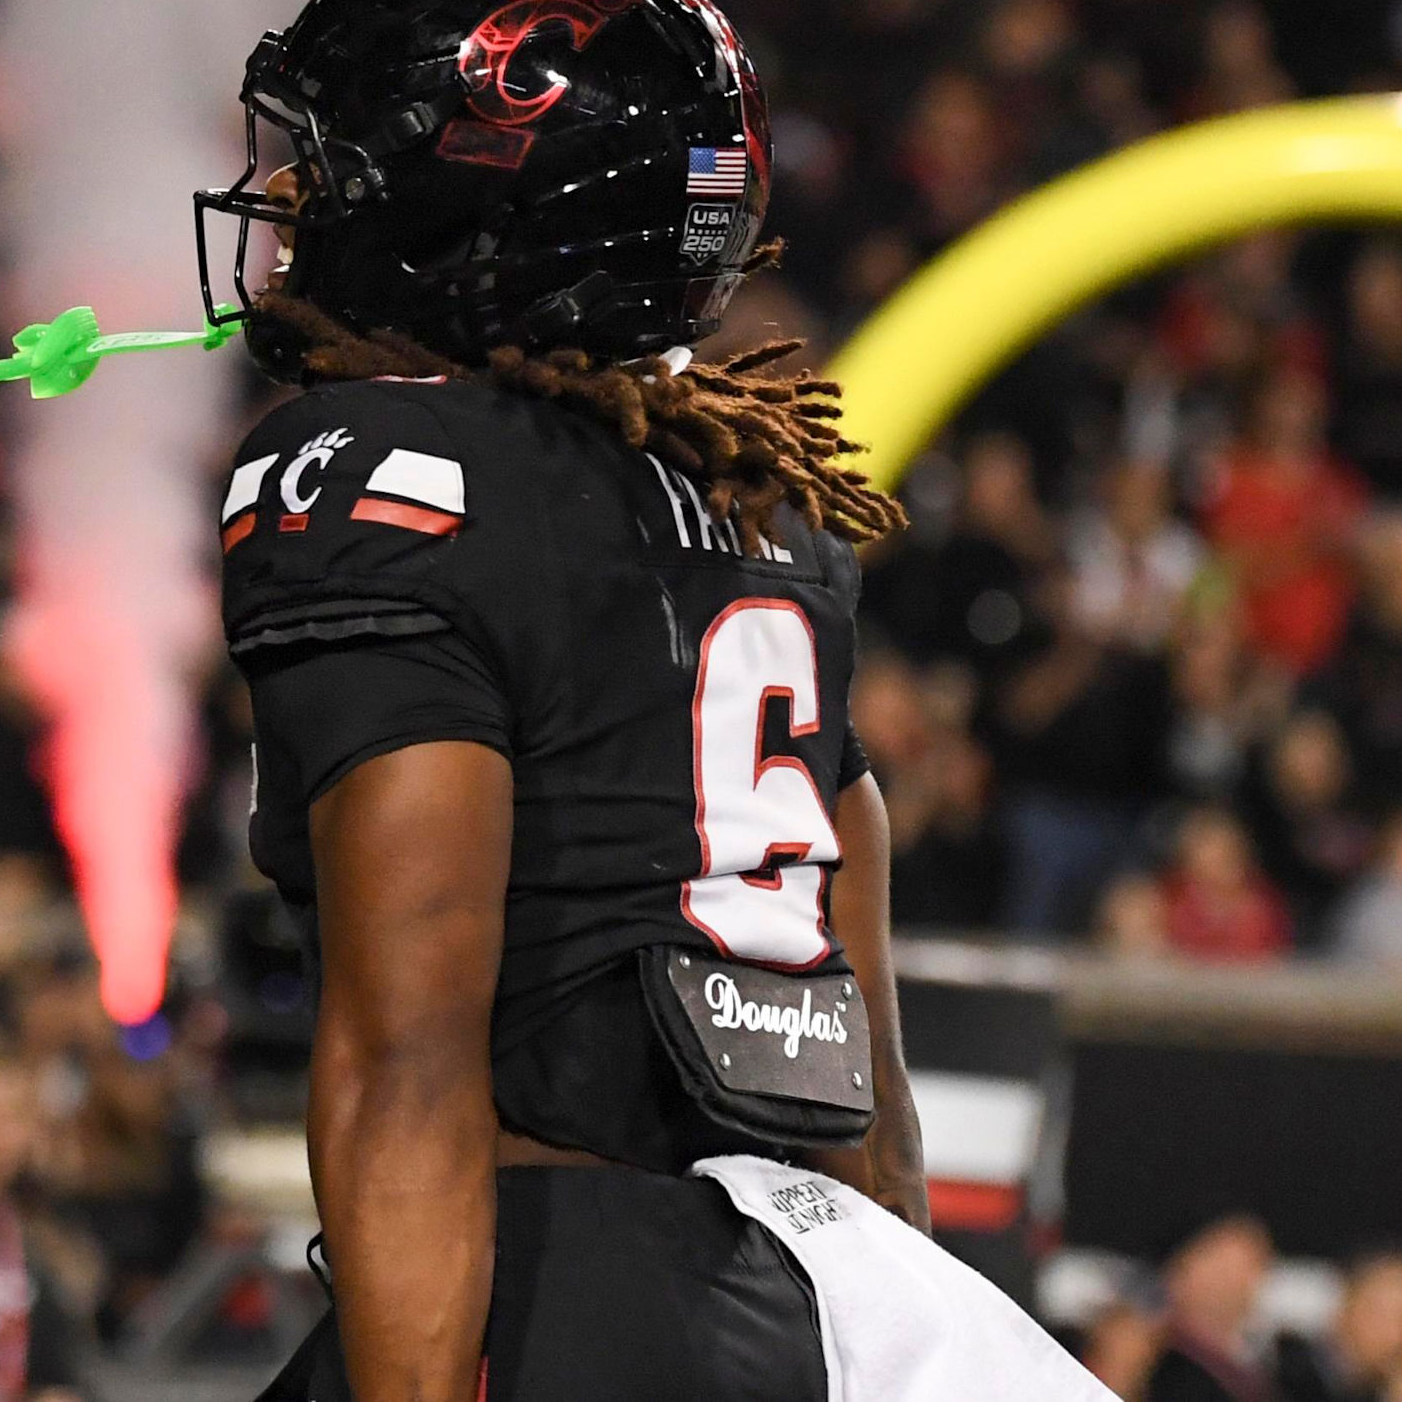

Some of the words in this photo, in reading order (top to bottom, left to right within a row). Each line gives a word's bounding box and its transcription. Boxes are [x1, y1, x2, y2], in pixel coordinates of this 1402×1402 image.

[682, 235, 726, 252] 250
[693, 210, 730, 225] USA
[678, 597, 843, 972] 6
[704, 972, 848, 1059] Douglas
